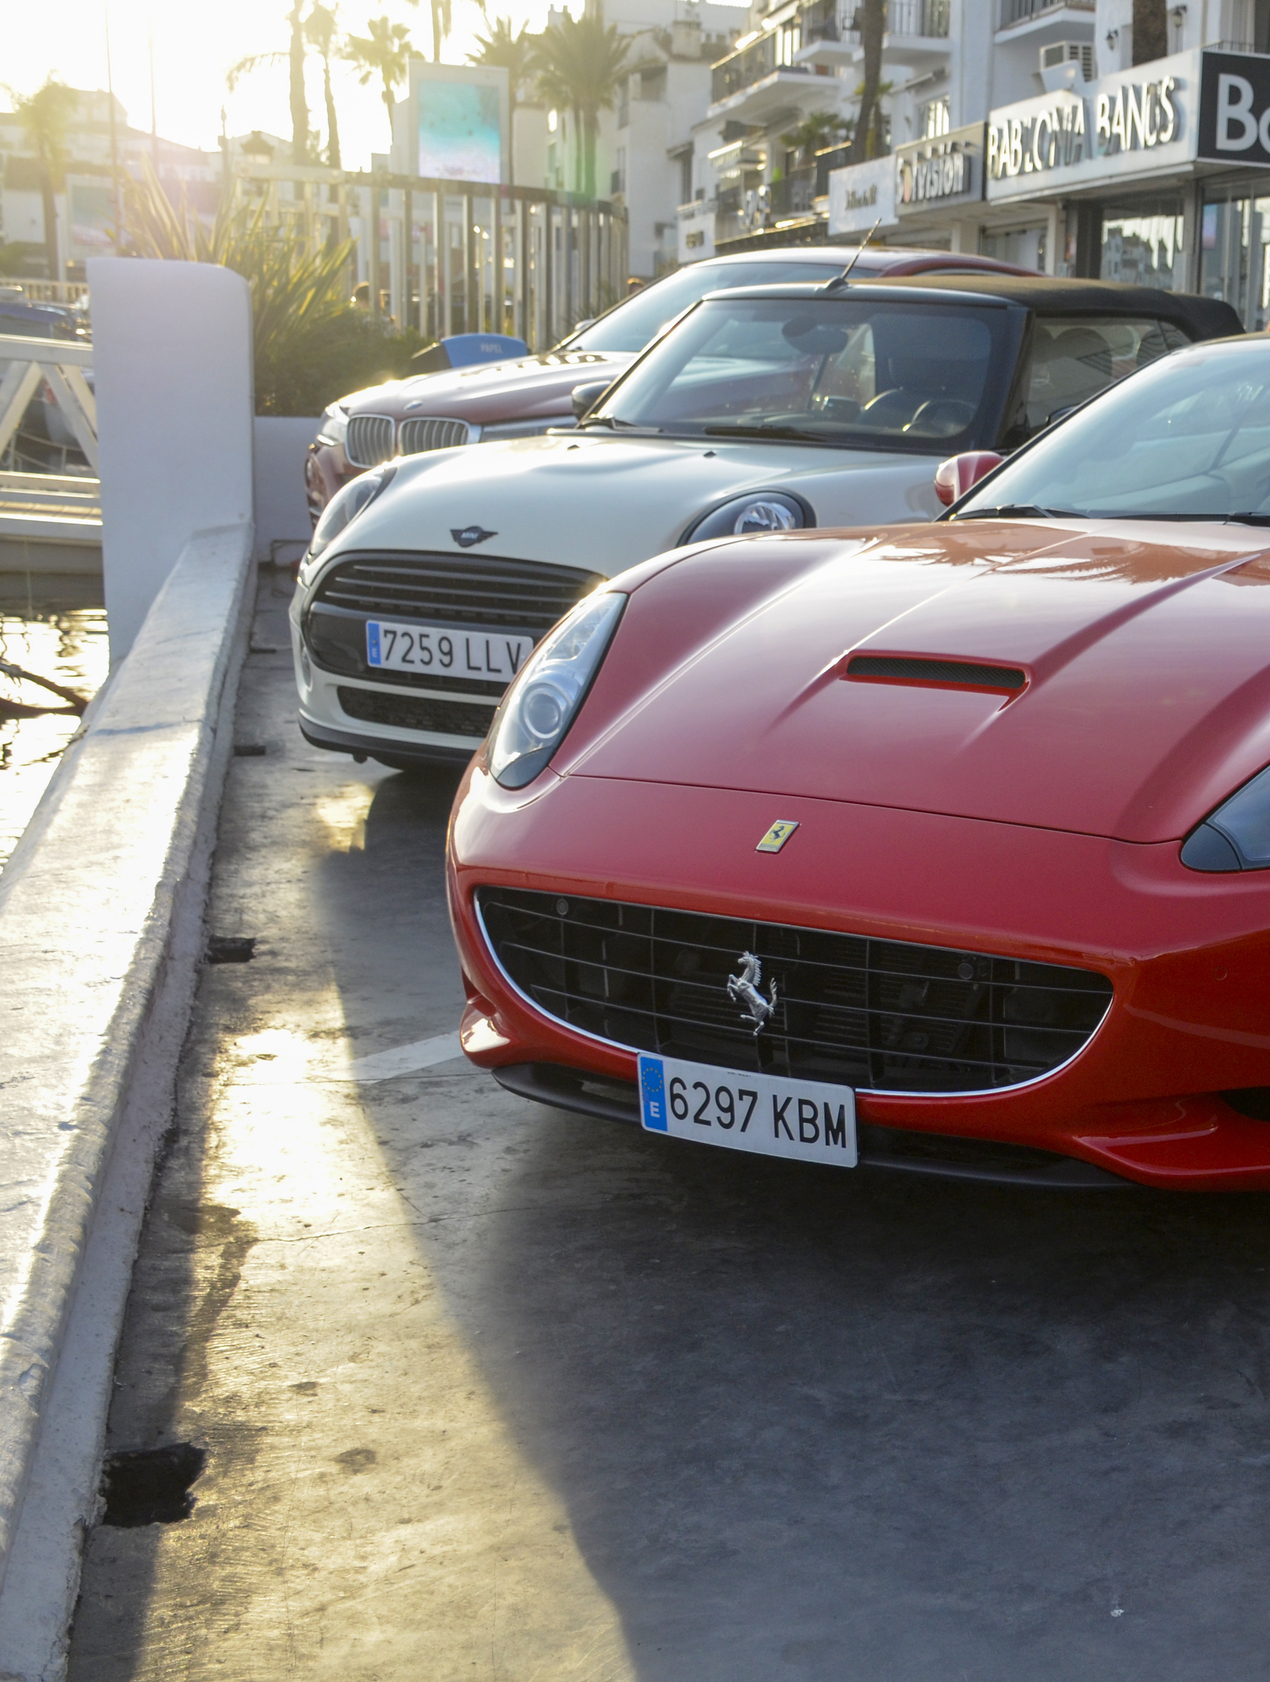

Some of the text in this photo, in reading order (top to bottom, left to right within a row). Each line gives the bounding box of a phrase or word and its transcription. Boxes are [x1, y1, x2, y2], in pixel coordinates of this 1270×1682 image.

[383, 629, 454, 668] 7259
[465, 638, 521, 675] LLV
[649, 1077, 847, 1149] E 6297 KBM
